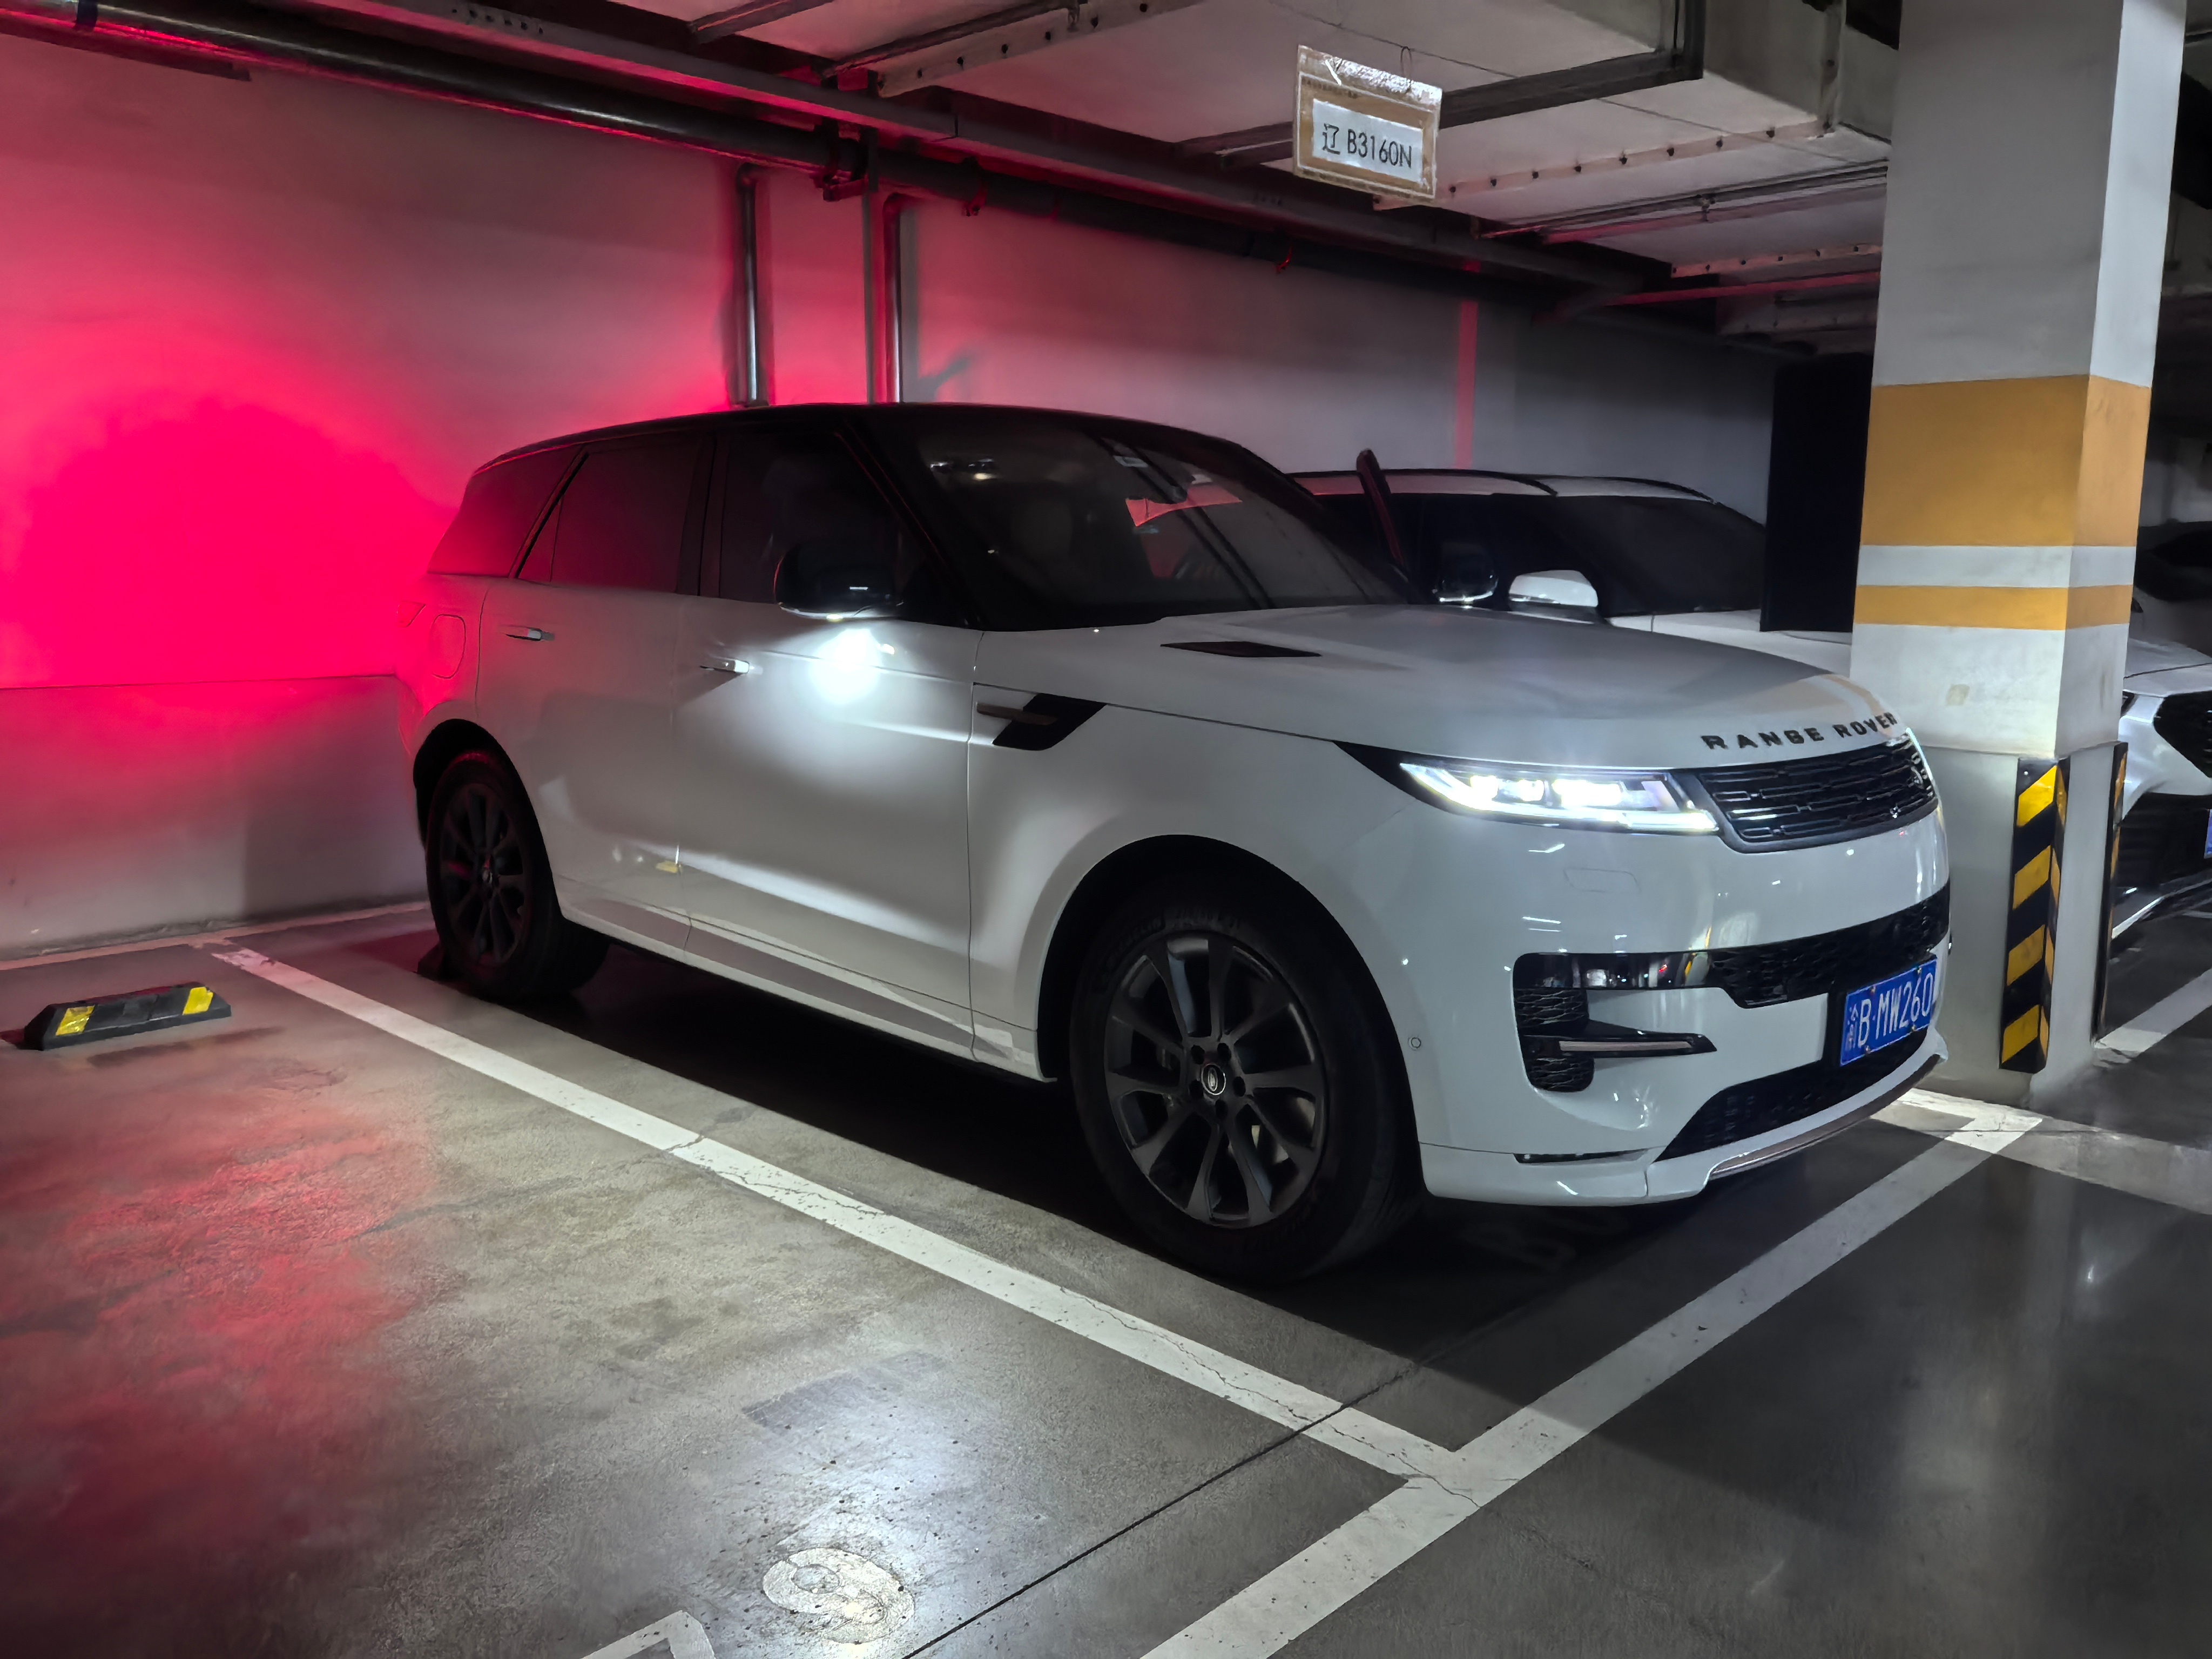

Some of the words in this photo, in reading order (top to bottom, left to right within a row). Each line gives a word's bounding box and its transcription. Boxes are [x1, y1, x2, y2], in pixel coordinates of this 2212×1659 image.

[1322, 123, 1340, 154] 辽
[1347, 129, 1412, 168] B3160N
[1700, 727, 1825, 750] RANGE
[1832, 711, 1898, 739] ROVER
